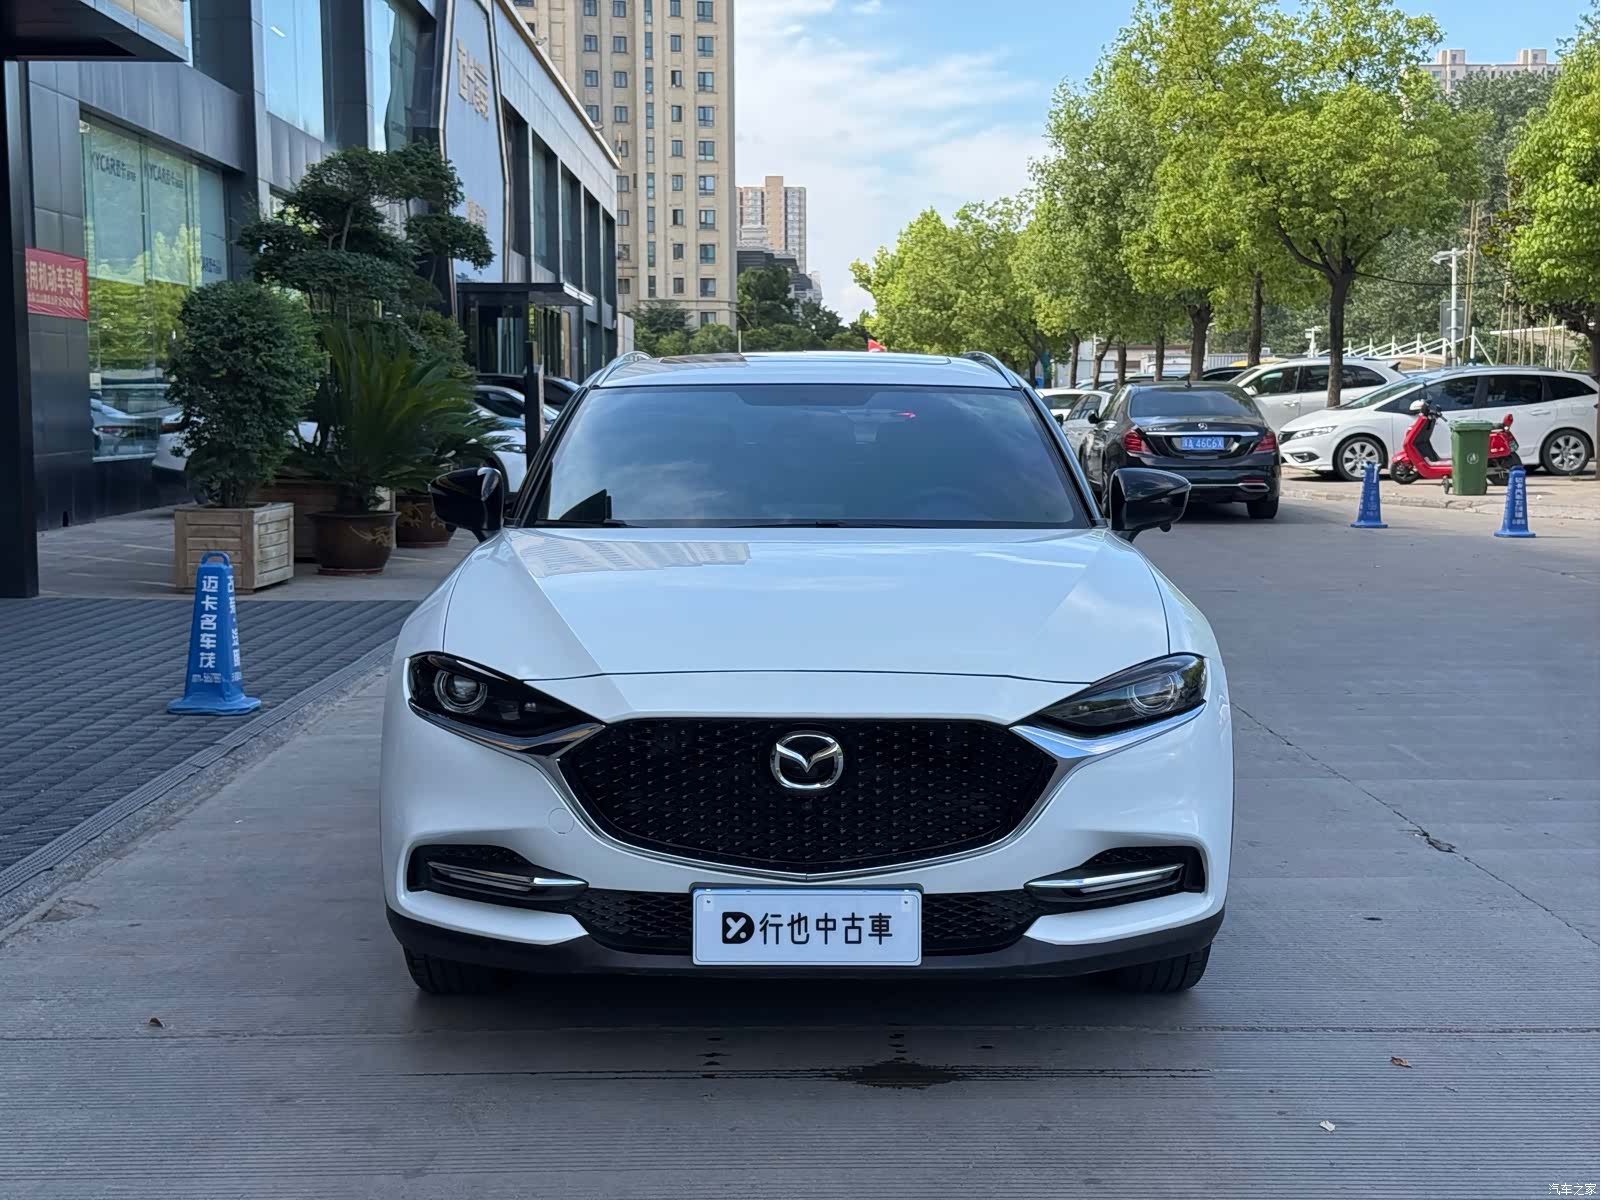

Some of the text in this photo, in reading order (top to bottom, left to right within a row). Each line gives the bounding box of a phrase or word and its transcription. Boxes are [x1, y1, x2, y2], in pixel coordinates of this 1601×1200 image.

[26, 260, 84, 298] 用机动车号牌
[199, 575, 219, 668] 迈卡名车茂
[759, 912, 893, 945] 行也中古車
